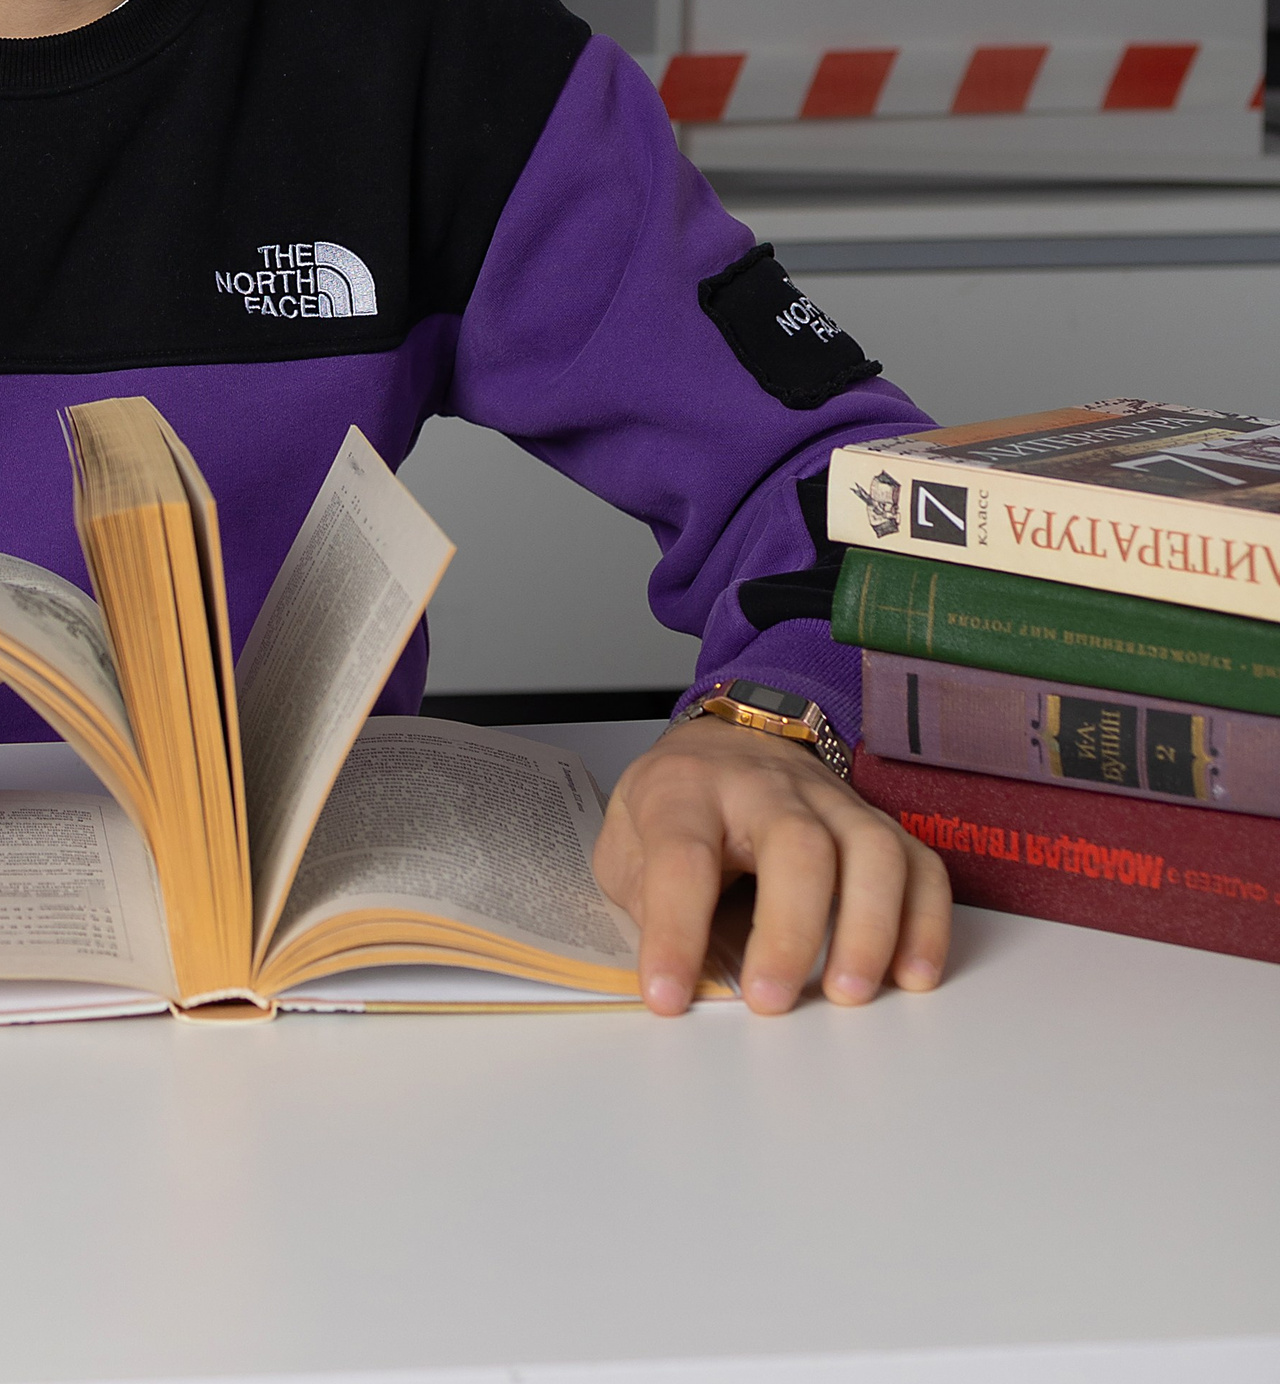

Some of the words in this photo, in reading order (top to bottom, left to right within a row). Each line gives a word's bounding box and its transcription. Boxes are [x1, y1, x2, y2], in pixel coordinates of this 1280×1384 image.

[257, 243, 314, 268] THE
[215, 267, 315, 295] NORTH
[244, 295, 319, 318] FACE
[968, 415, 1210, 462] ЛИТЕРАТУРА
[917, 485, 966, 532] 7
[1006, 504, 1280, 588] ЛИТЕРАТУРА
[1101, 710, 1128, 782] БУНИН
[1155, 744, 1176, 763] 2
[1027, 833, 1164, 889] МОЛОДАЯ
